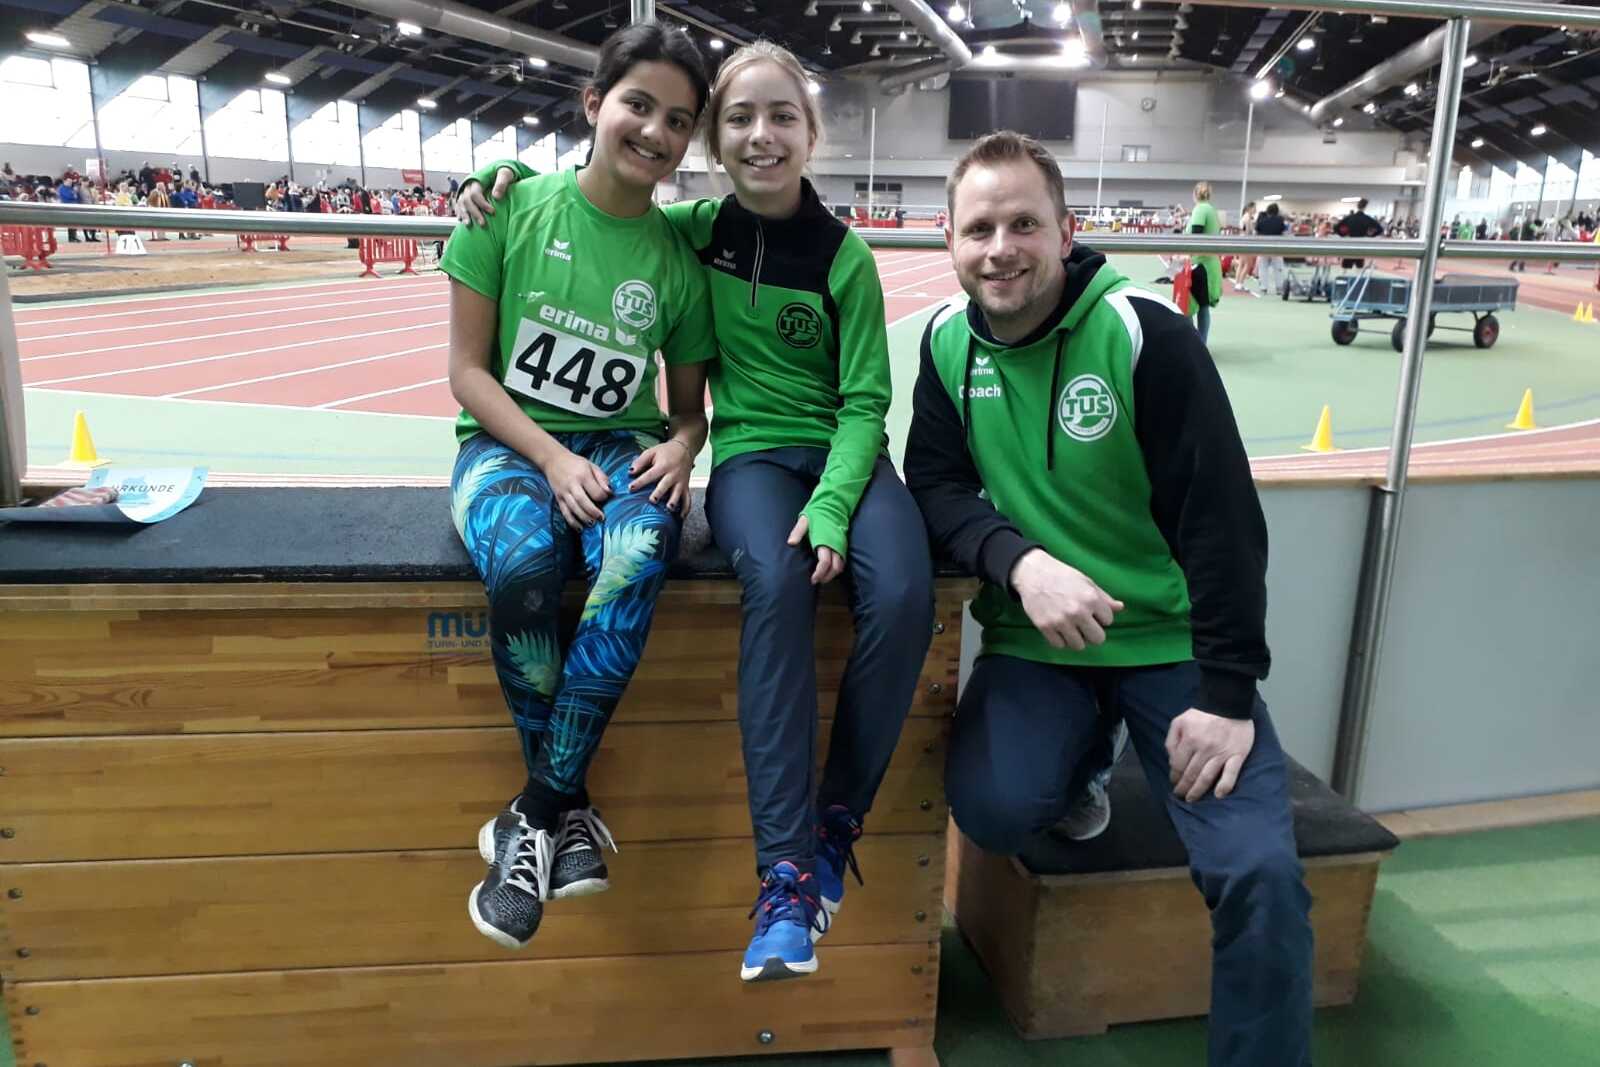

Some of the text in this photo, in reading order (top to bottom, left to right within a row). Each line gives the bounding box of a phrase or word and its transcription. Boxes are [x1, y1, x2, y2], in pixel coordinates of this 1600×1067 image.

[545, 249, 571, 261] erima
[620, 292, 653, 317] TUS
[539, 303, 610, 341] erima
[783, 317, 818, 335] TUS
[515, 332, 636, 412] 448
[1065, 396, 1110, 416] TUS
[462, 640, 481, 648] UND
